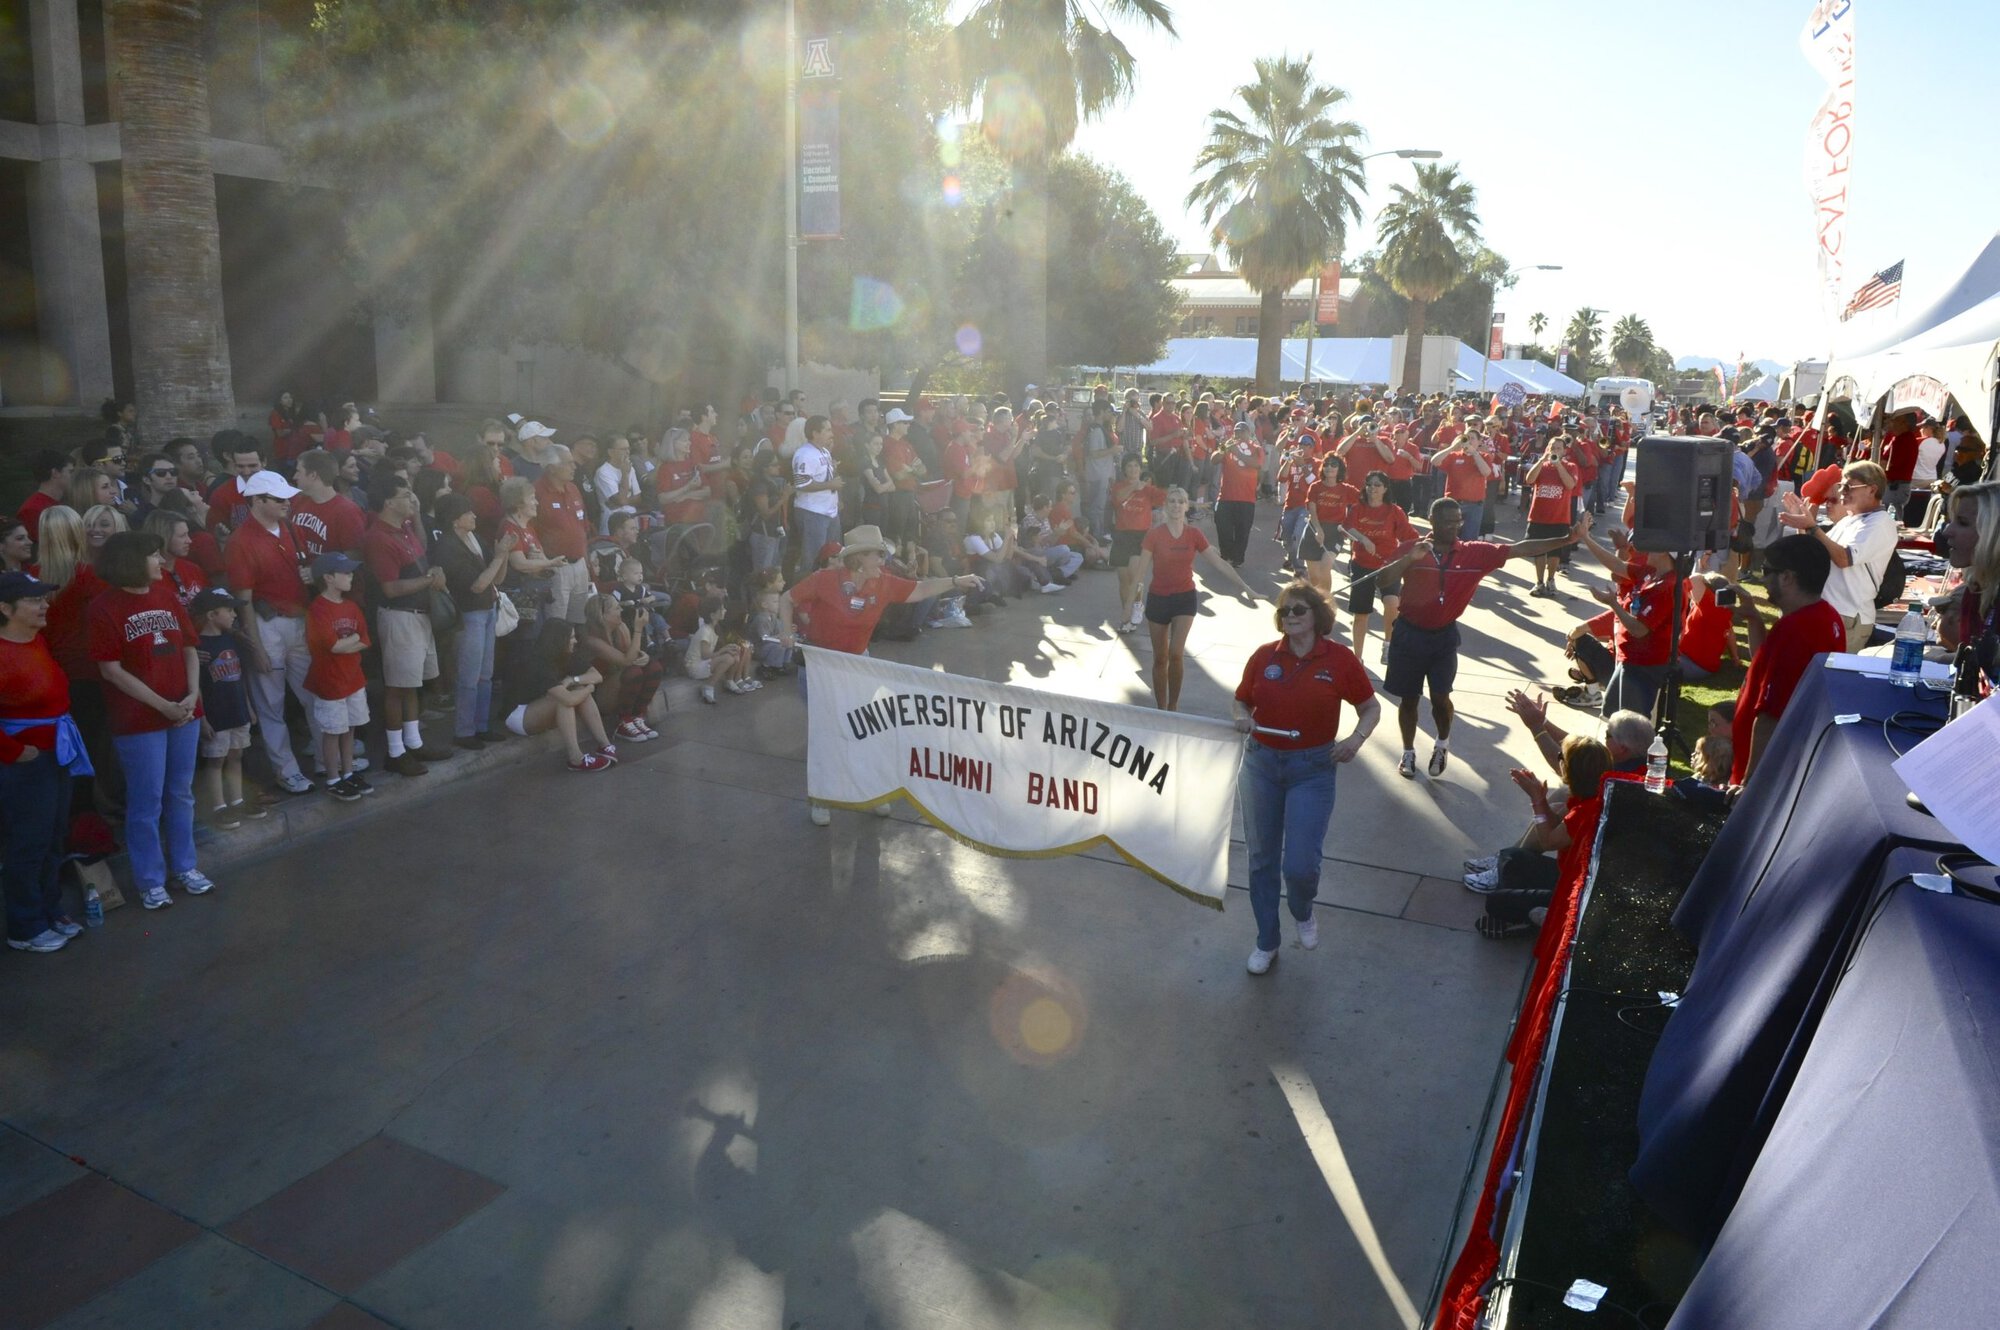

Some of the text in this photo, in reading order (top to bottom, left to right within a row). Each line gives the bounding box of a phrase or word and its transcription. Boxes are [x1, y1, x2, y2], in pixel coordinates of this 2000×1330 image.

[802, 38, 834, 79] A
[124, 614, 179, 642] ARIZON
[847, 693, 1171, 796] UNIVERSITY OF ARIZONA
[909, 746, 1099, 815] ALUMNI BAND
